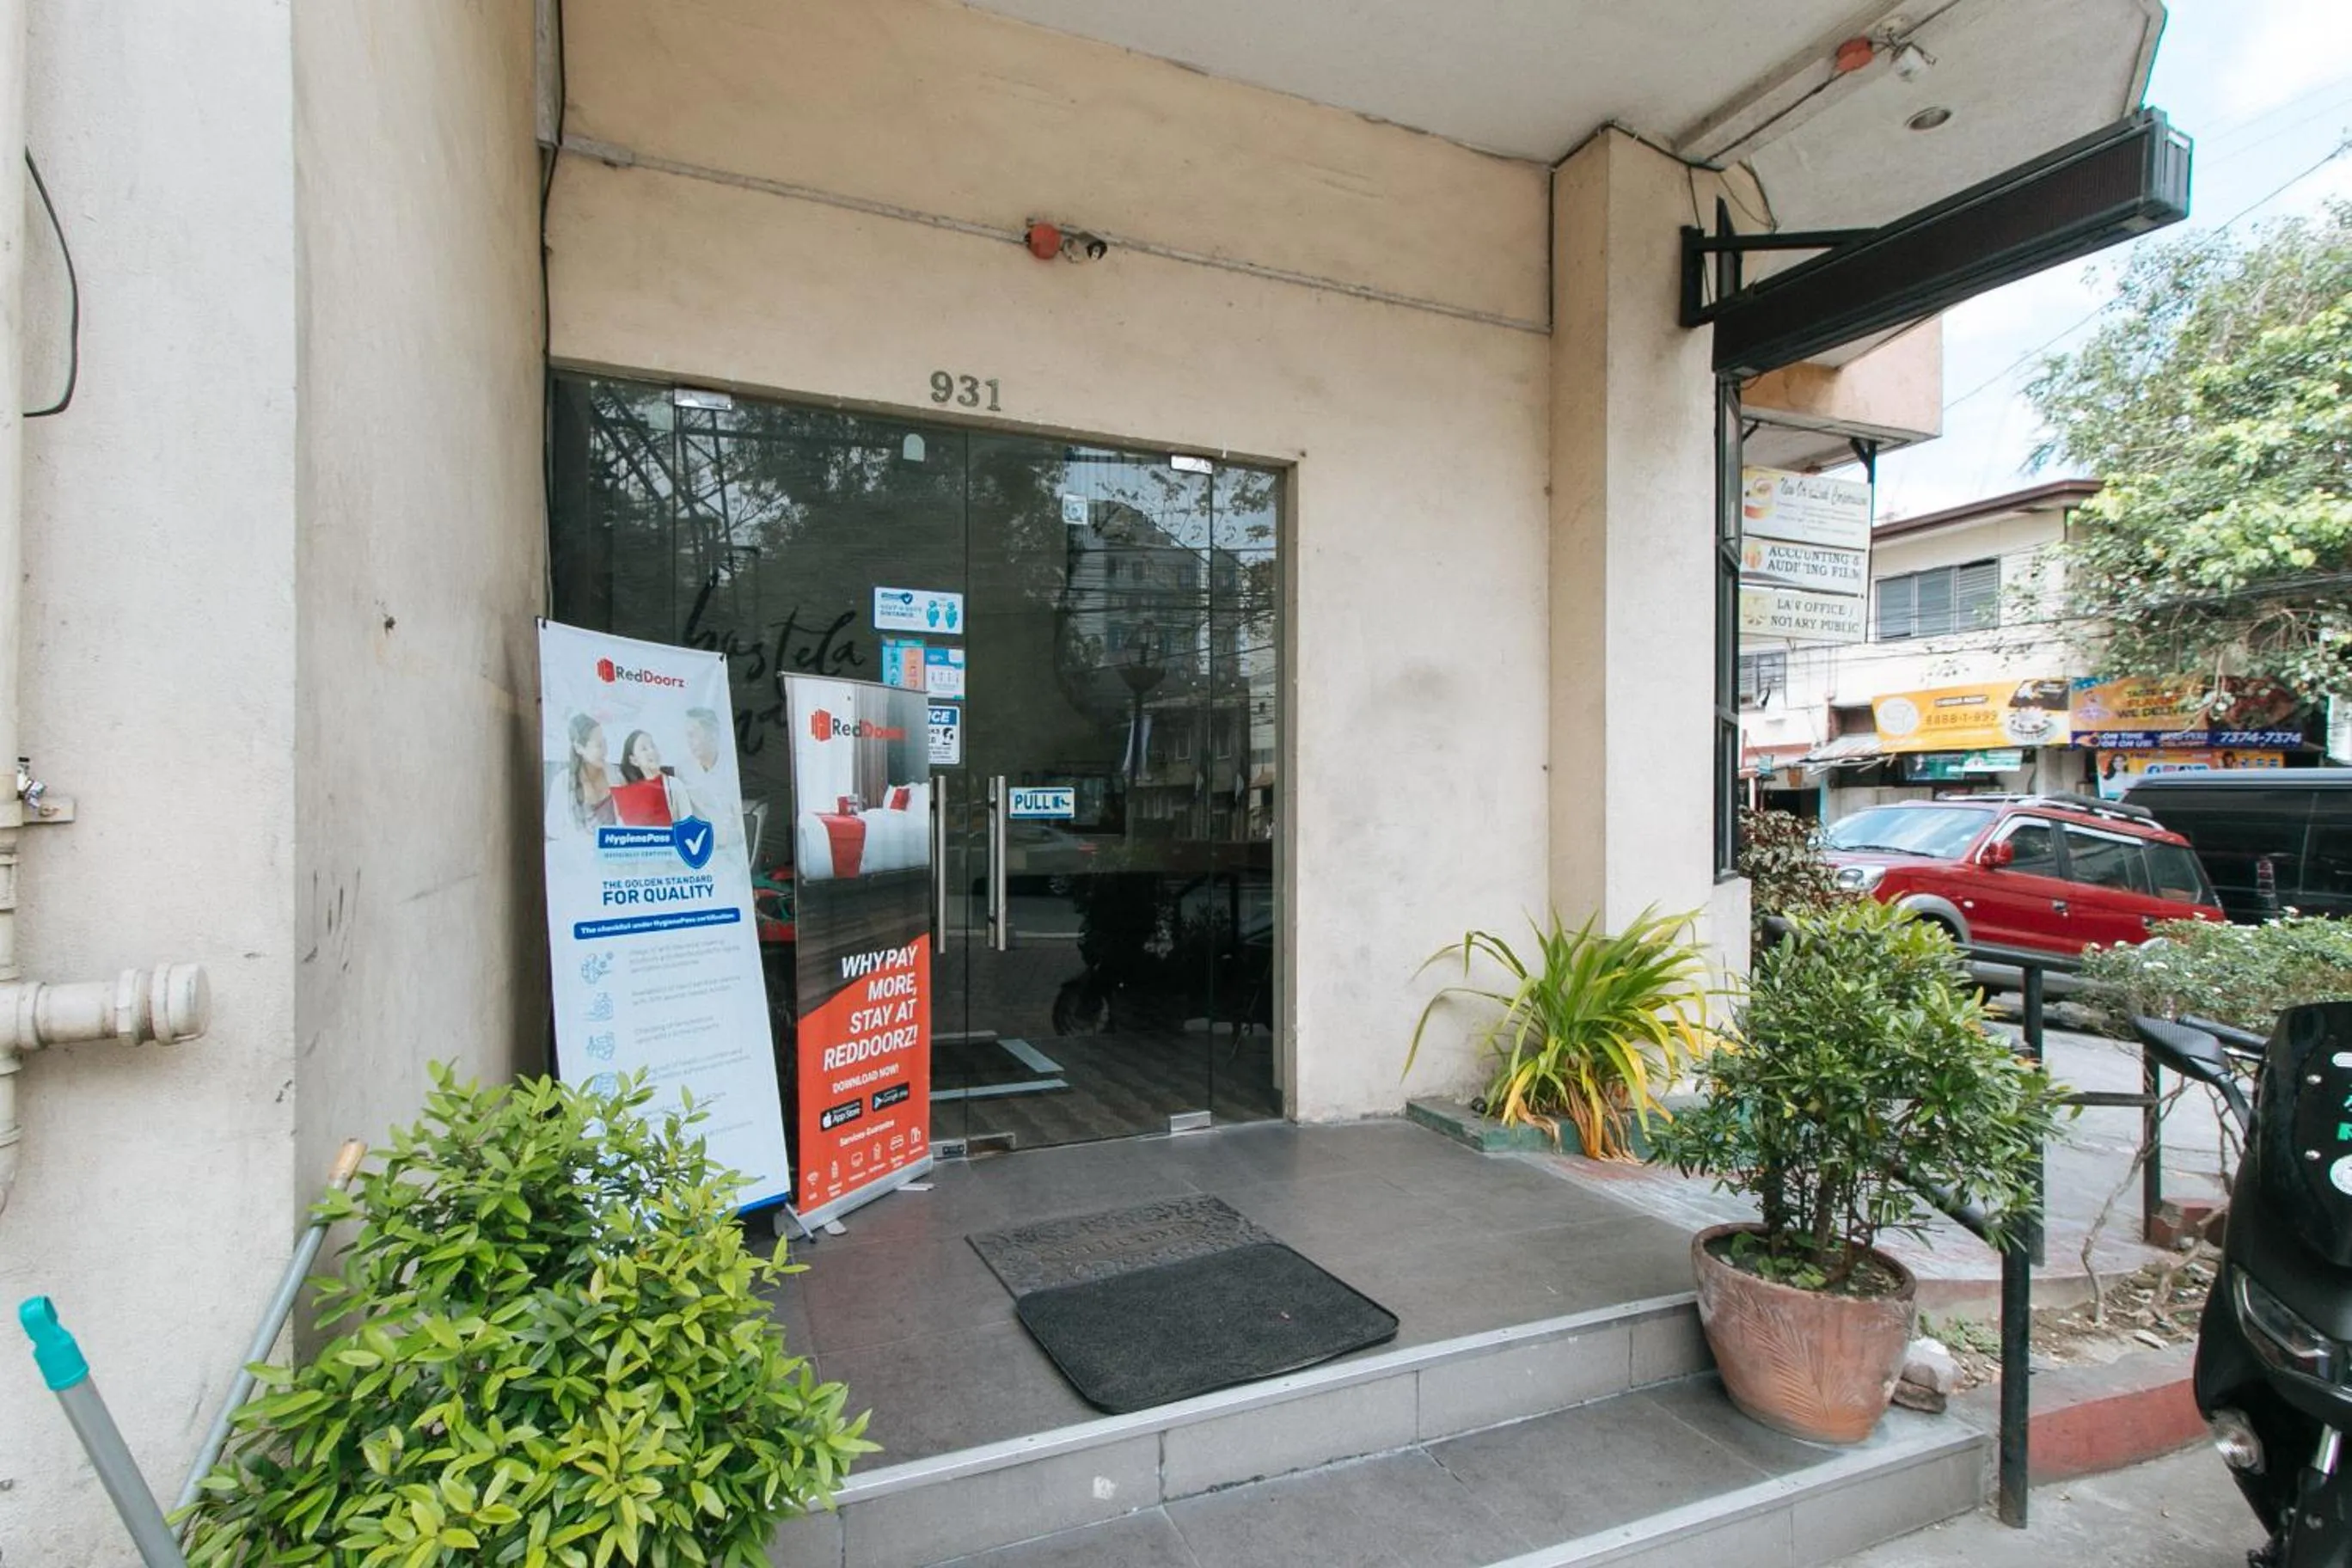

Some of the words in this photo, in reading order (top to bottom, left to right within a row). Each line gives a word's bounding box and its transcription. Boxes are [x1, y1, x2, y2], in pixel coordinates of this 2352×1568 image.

[930, 371, 1001, 411] 931
[1804, 602, 1847, 616] OFFICE
[1771, 616, 1816, 629] NOTARY
[1821, 620, 1860, 633] PUBLIC
[616, 665, 685, 687] RedDoorz
[1014, 794, 1050, 810] PULL
[604, 833, 671, 845] HygienePass
[603, 880, 622, 889] THE
[625, 878, 663, 888] GOLDEN
[665, 874, 713, 885] STANDARD
[603, 890, 639, 906] FOR
[644, 884, 714, 903] QUALITY
[867, 972, 917, 1001] MORE,
[849, 1003, 893, 1034] STAY
[895, 999, 917, 1023] AT
[823, 1025, 918, 1072] REDDOORZ!
[832, 1070, 879, 1094] DOWNLOAD
